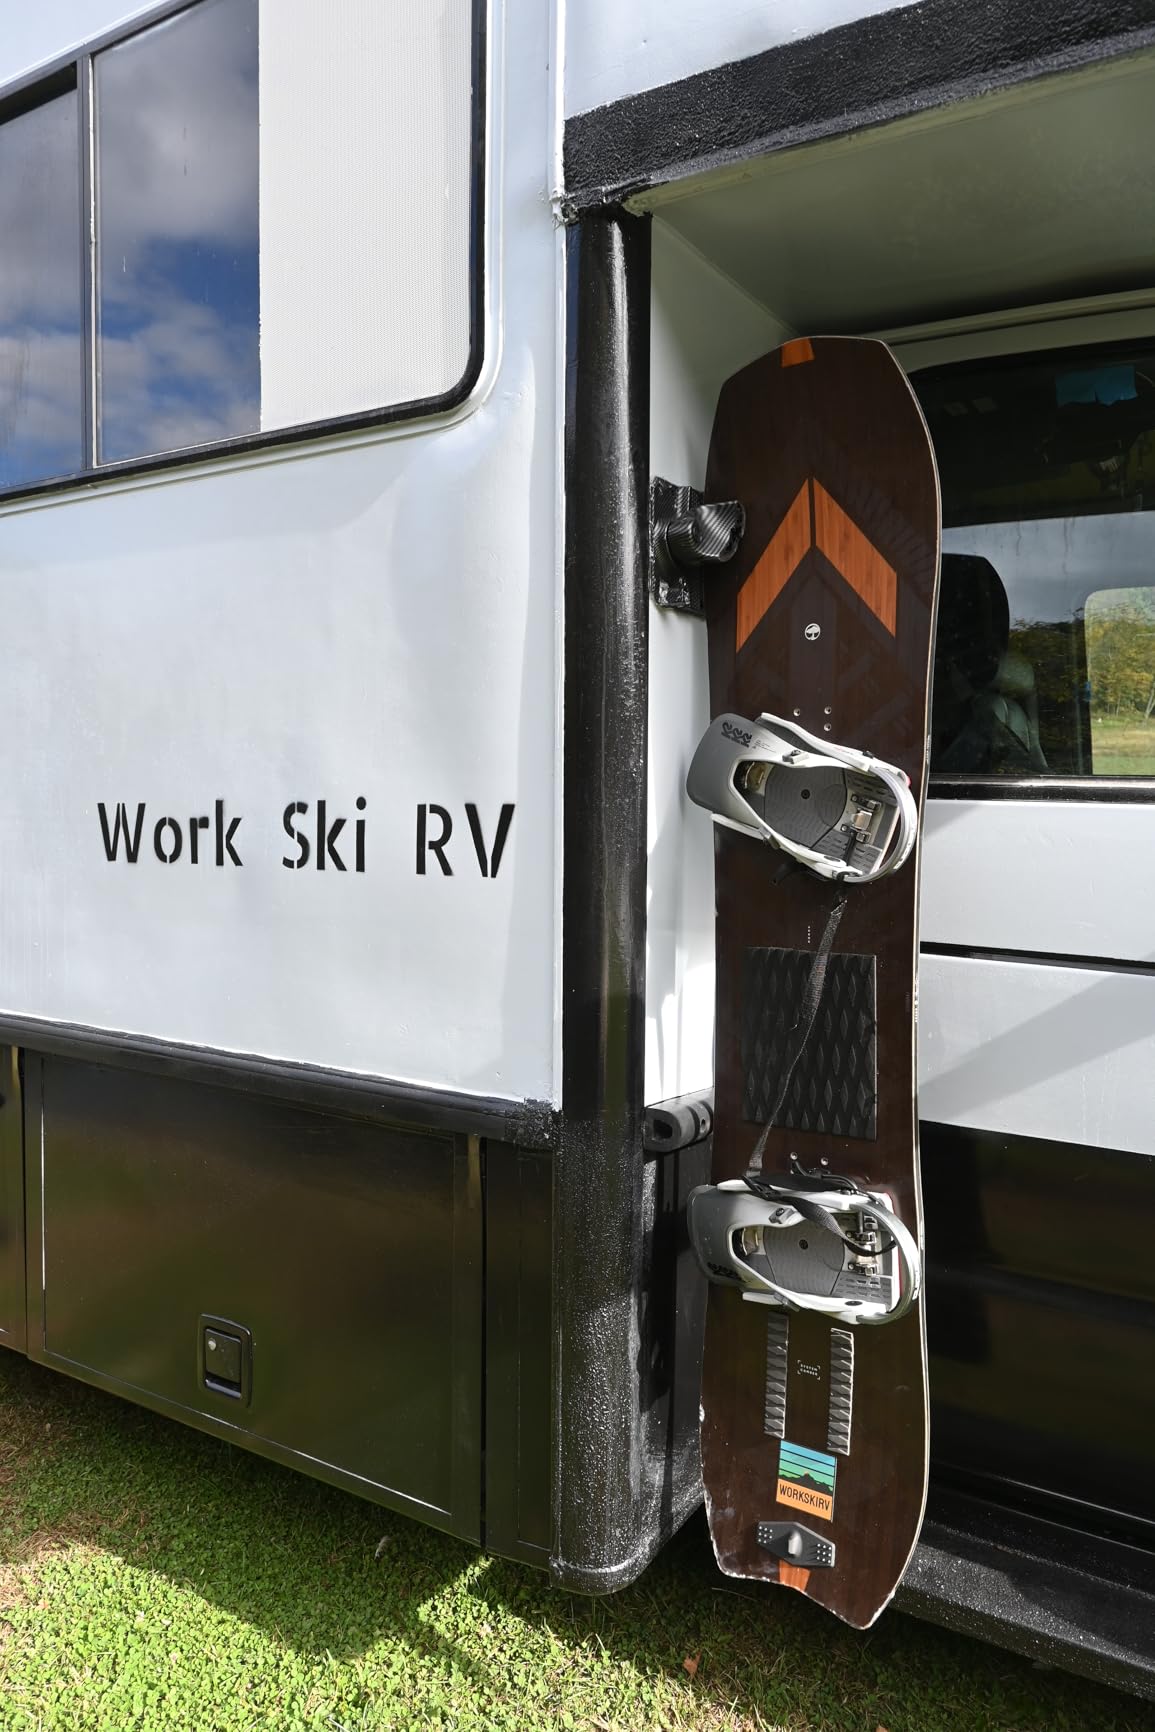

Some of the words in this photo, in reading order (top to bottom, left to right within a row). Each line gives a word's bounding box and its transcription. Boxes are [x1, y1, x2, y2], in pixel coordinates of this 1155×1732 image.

[97, 799, 244, 867] Work
[282, 796, 367, 873] Ski
[415, 802, 516, 879] RV
[779, 1483, 830, 1511] WORKSKIRV
